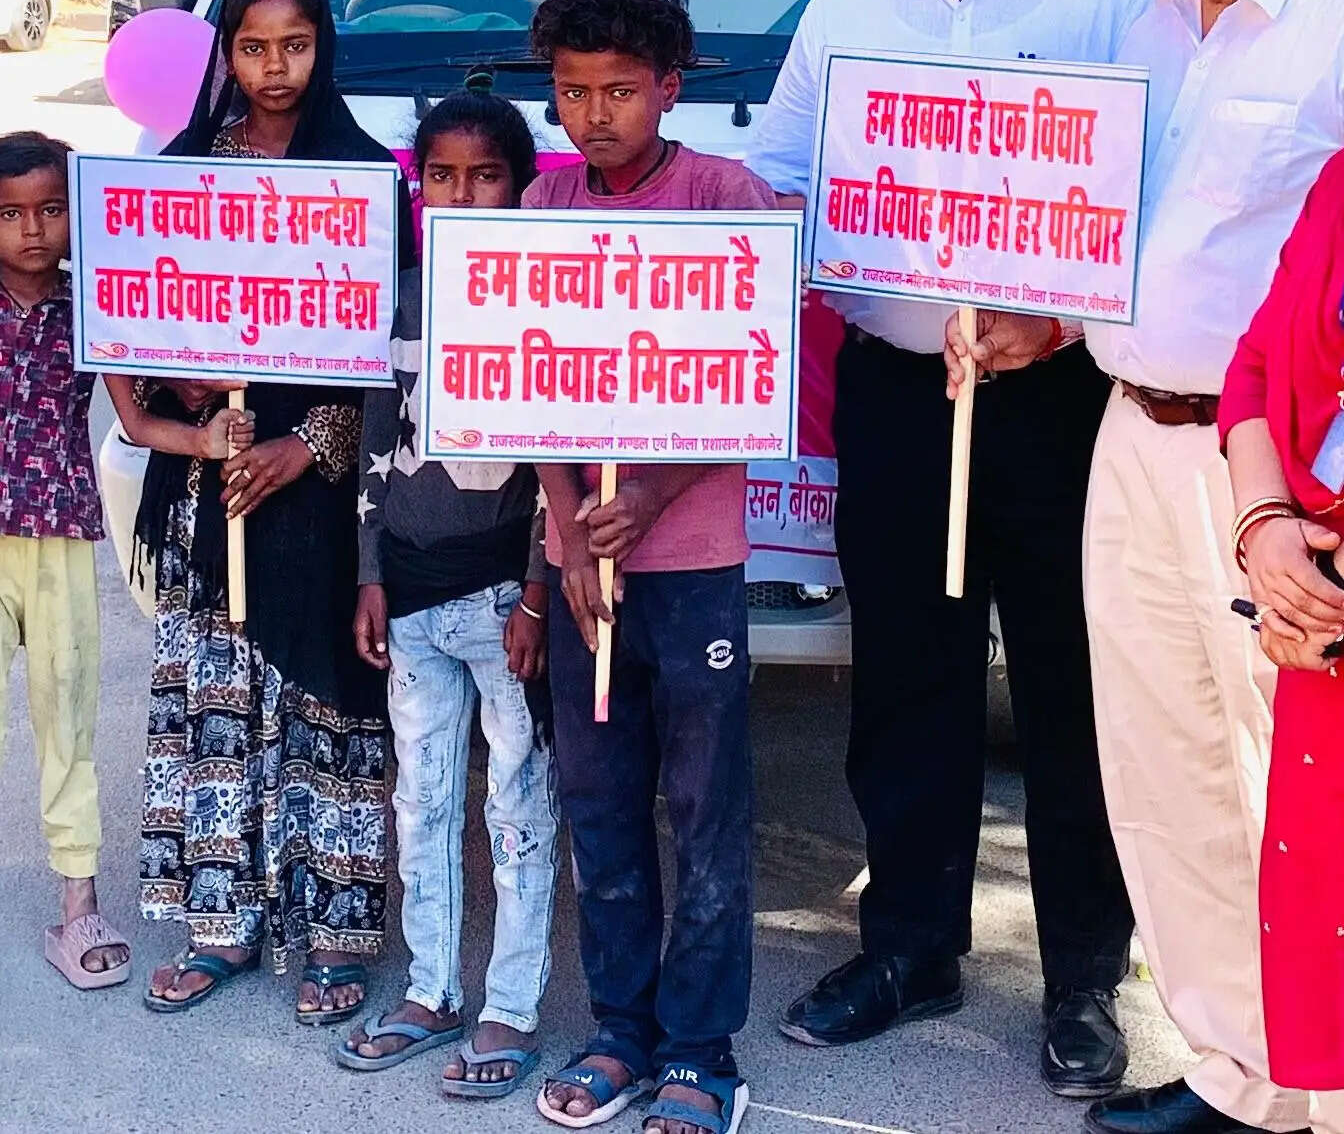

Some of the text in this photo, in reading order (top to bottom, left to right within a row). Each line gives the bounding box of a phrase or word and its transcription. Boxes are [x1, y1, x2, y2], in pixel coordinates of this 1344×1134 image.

[865, 79, 1098, 166] हम सबका है एक विचार
[104, 174, 369, 247] हम बच्चों का है सन्देश
[827, 165, 1127, 268] बाल विवाह मुक्त हो हर परिवार
[95, 256, 380, 345] बाल विवाह मुक्त हो देश
[466, 233, 759, 311] हम बच्चों ने ठाना है
[442, 328, 779, 405] बाल विवाह मिटाना है
[664, 1068, 698, 1084] AIR
